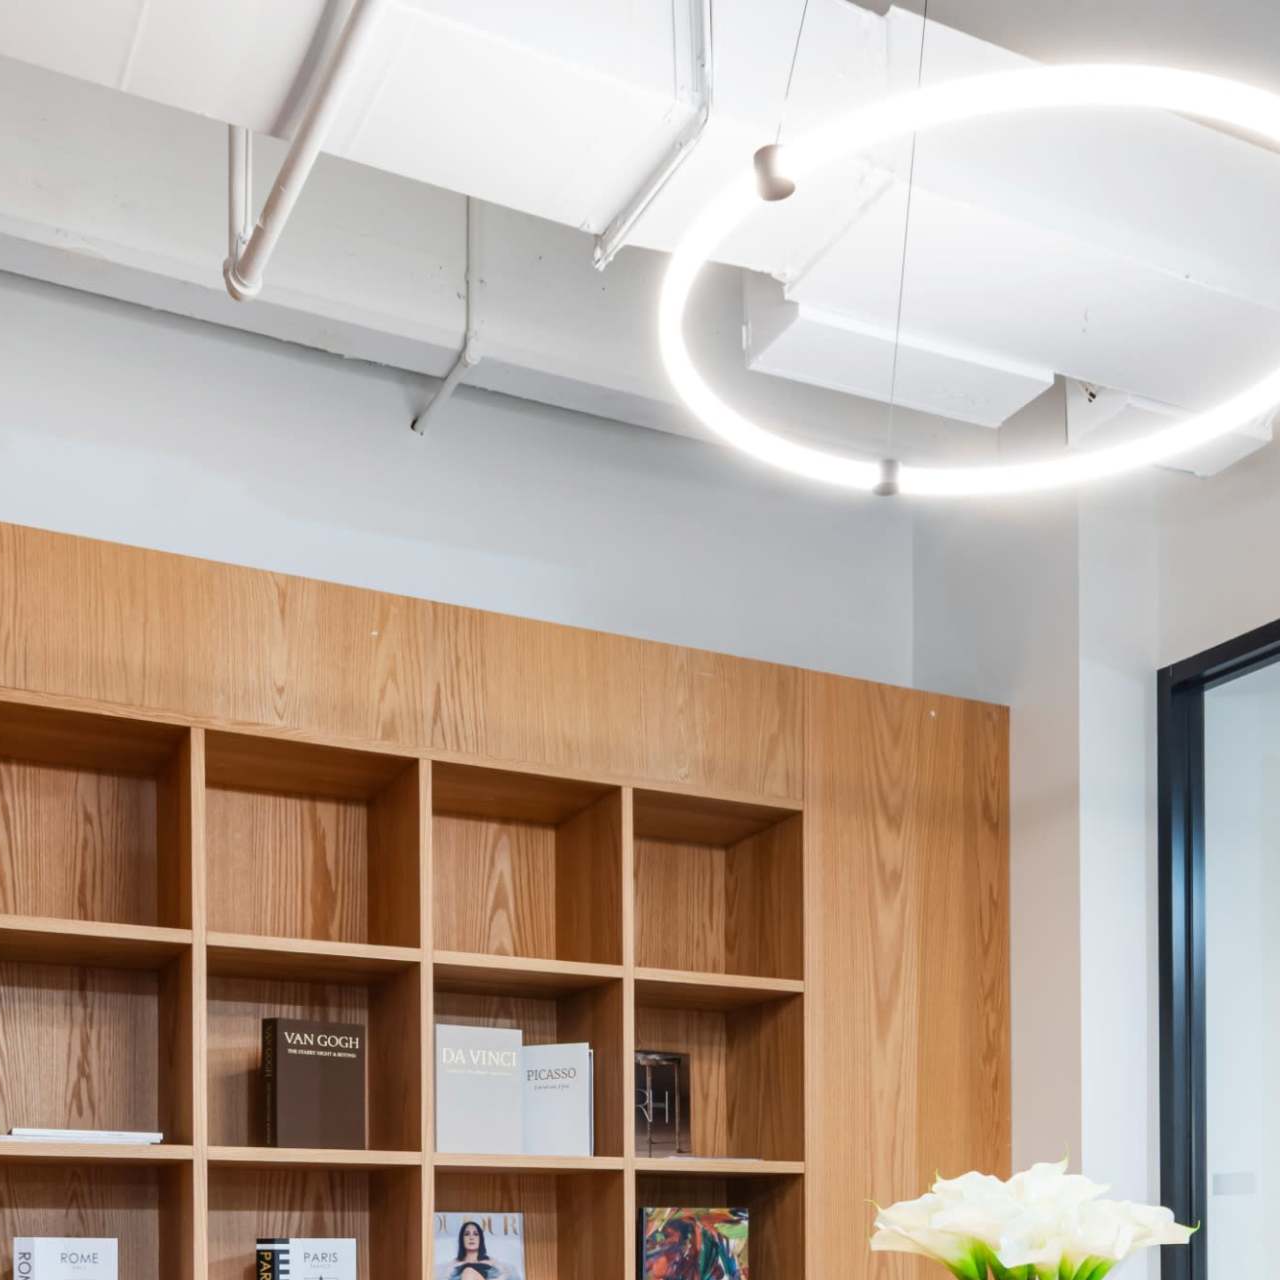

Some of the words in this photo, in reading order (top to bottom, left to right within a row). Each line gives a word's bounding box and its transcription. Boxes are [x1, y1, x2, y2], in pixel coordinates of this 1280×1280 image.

[284, 1031, 314, 1046] VAN
[317, 1034, 360, 1049] GOGH
[442, 1047, 466, 1065] DA
[470, 1049, 517, 1067] VINCI
[526, 1067, 577, 1081] PICASSO
[60, 1252, 99, 1264] ROME
[303, 1252, 338, 1263] PARIS
